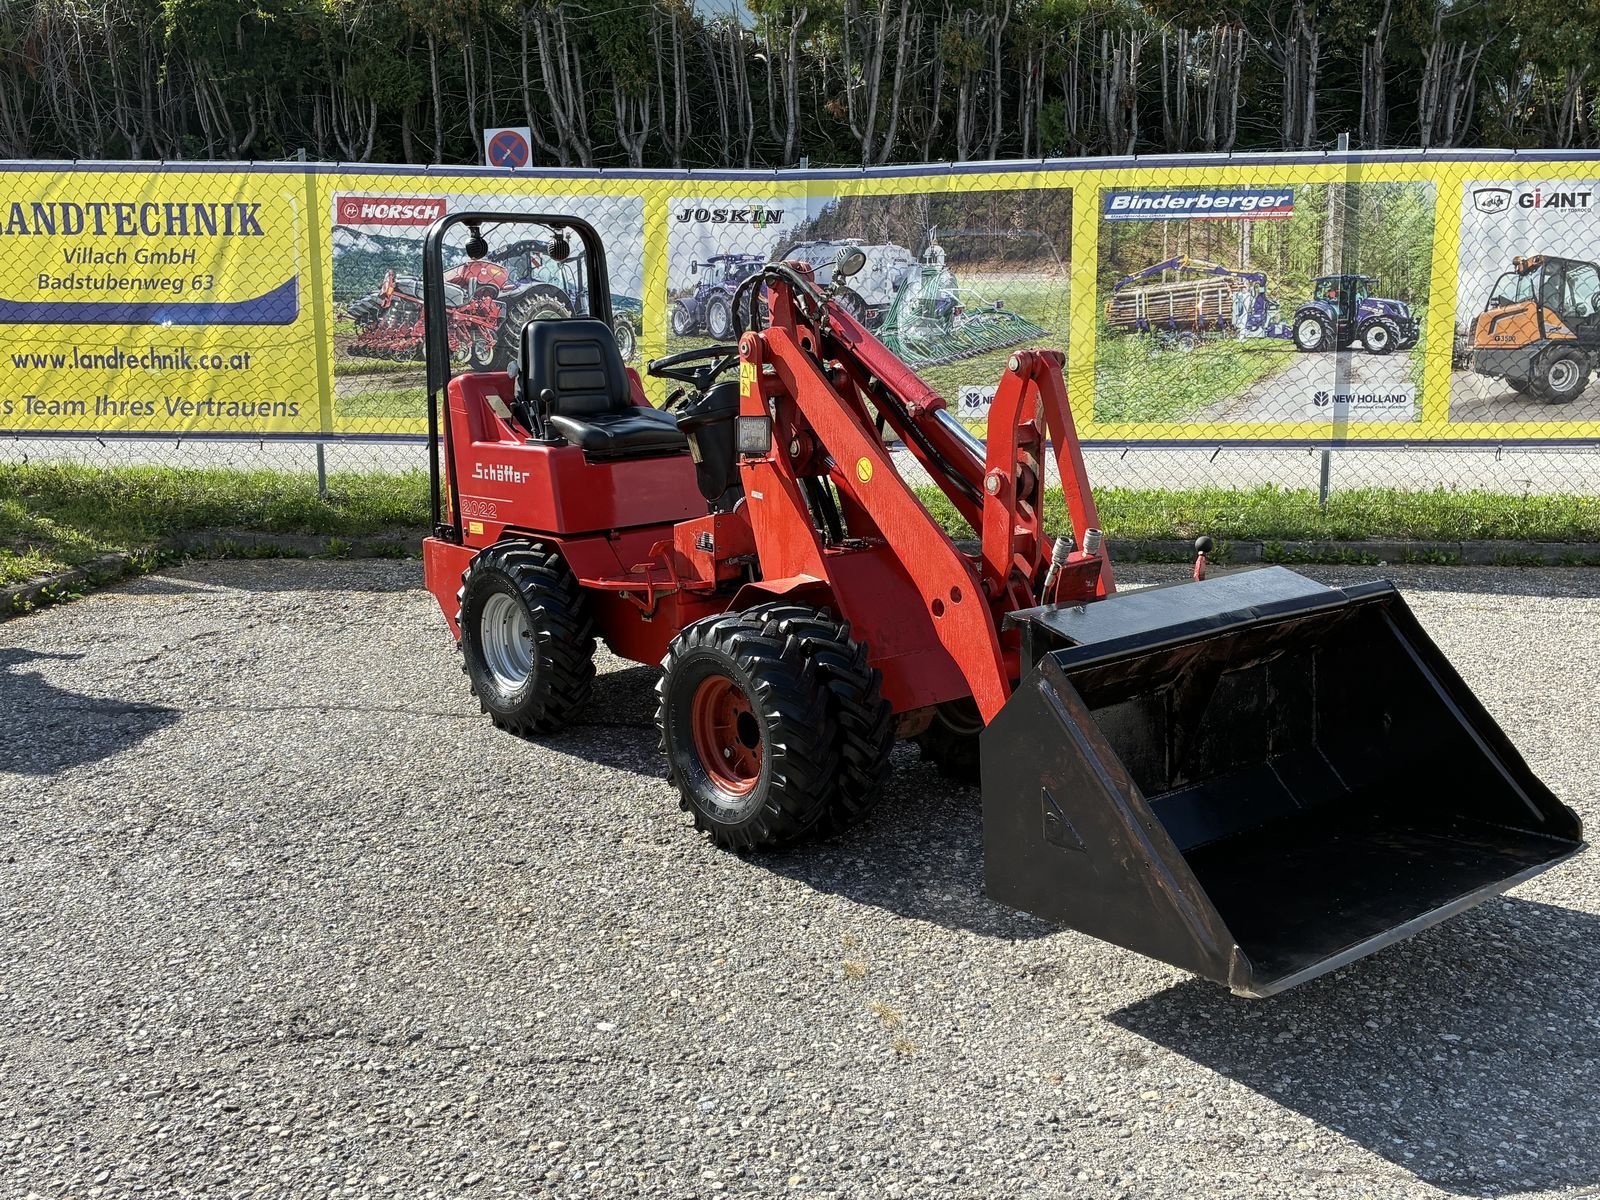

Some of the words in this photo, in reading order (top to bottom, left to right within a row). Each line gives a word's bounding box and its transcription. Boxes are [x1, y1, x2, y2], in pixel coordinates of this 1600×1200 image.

[361, 204, 440, 219] HORSCH
[1110, 194, 1290, 211] Binderberger
[0, 202, 264, 236] ANDTECHNIK
[677, 208, 784, 224] JOSKIN
[63, 248, 127, 264] Villach
[134, 248, 196, 265] GmbH
[38, 273, 185, 295] Badstubenweg
[191, 274, 214, 290] 63
[10, 346, 250, 369] www.landtechnik.co.at
[22, 395, 85, 415] Team
[95, 395, 155, 416] Ihres
[164, 396, 299, 417] Vertrauens
[1332, 394, 1356, 403] NEW
[1357, 394, 1407, 403] HOLLAND
[471, 463, 530, 484] Schäffer
[462, 499, 498, 519] 2022
